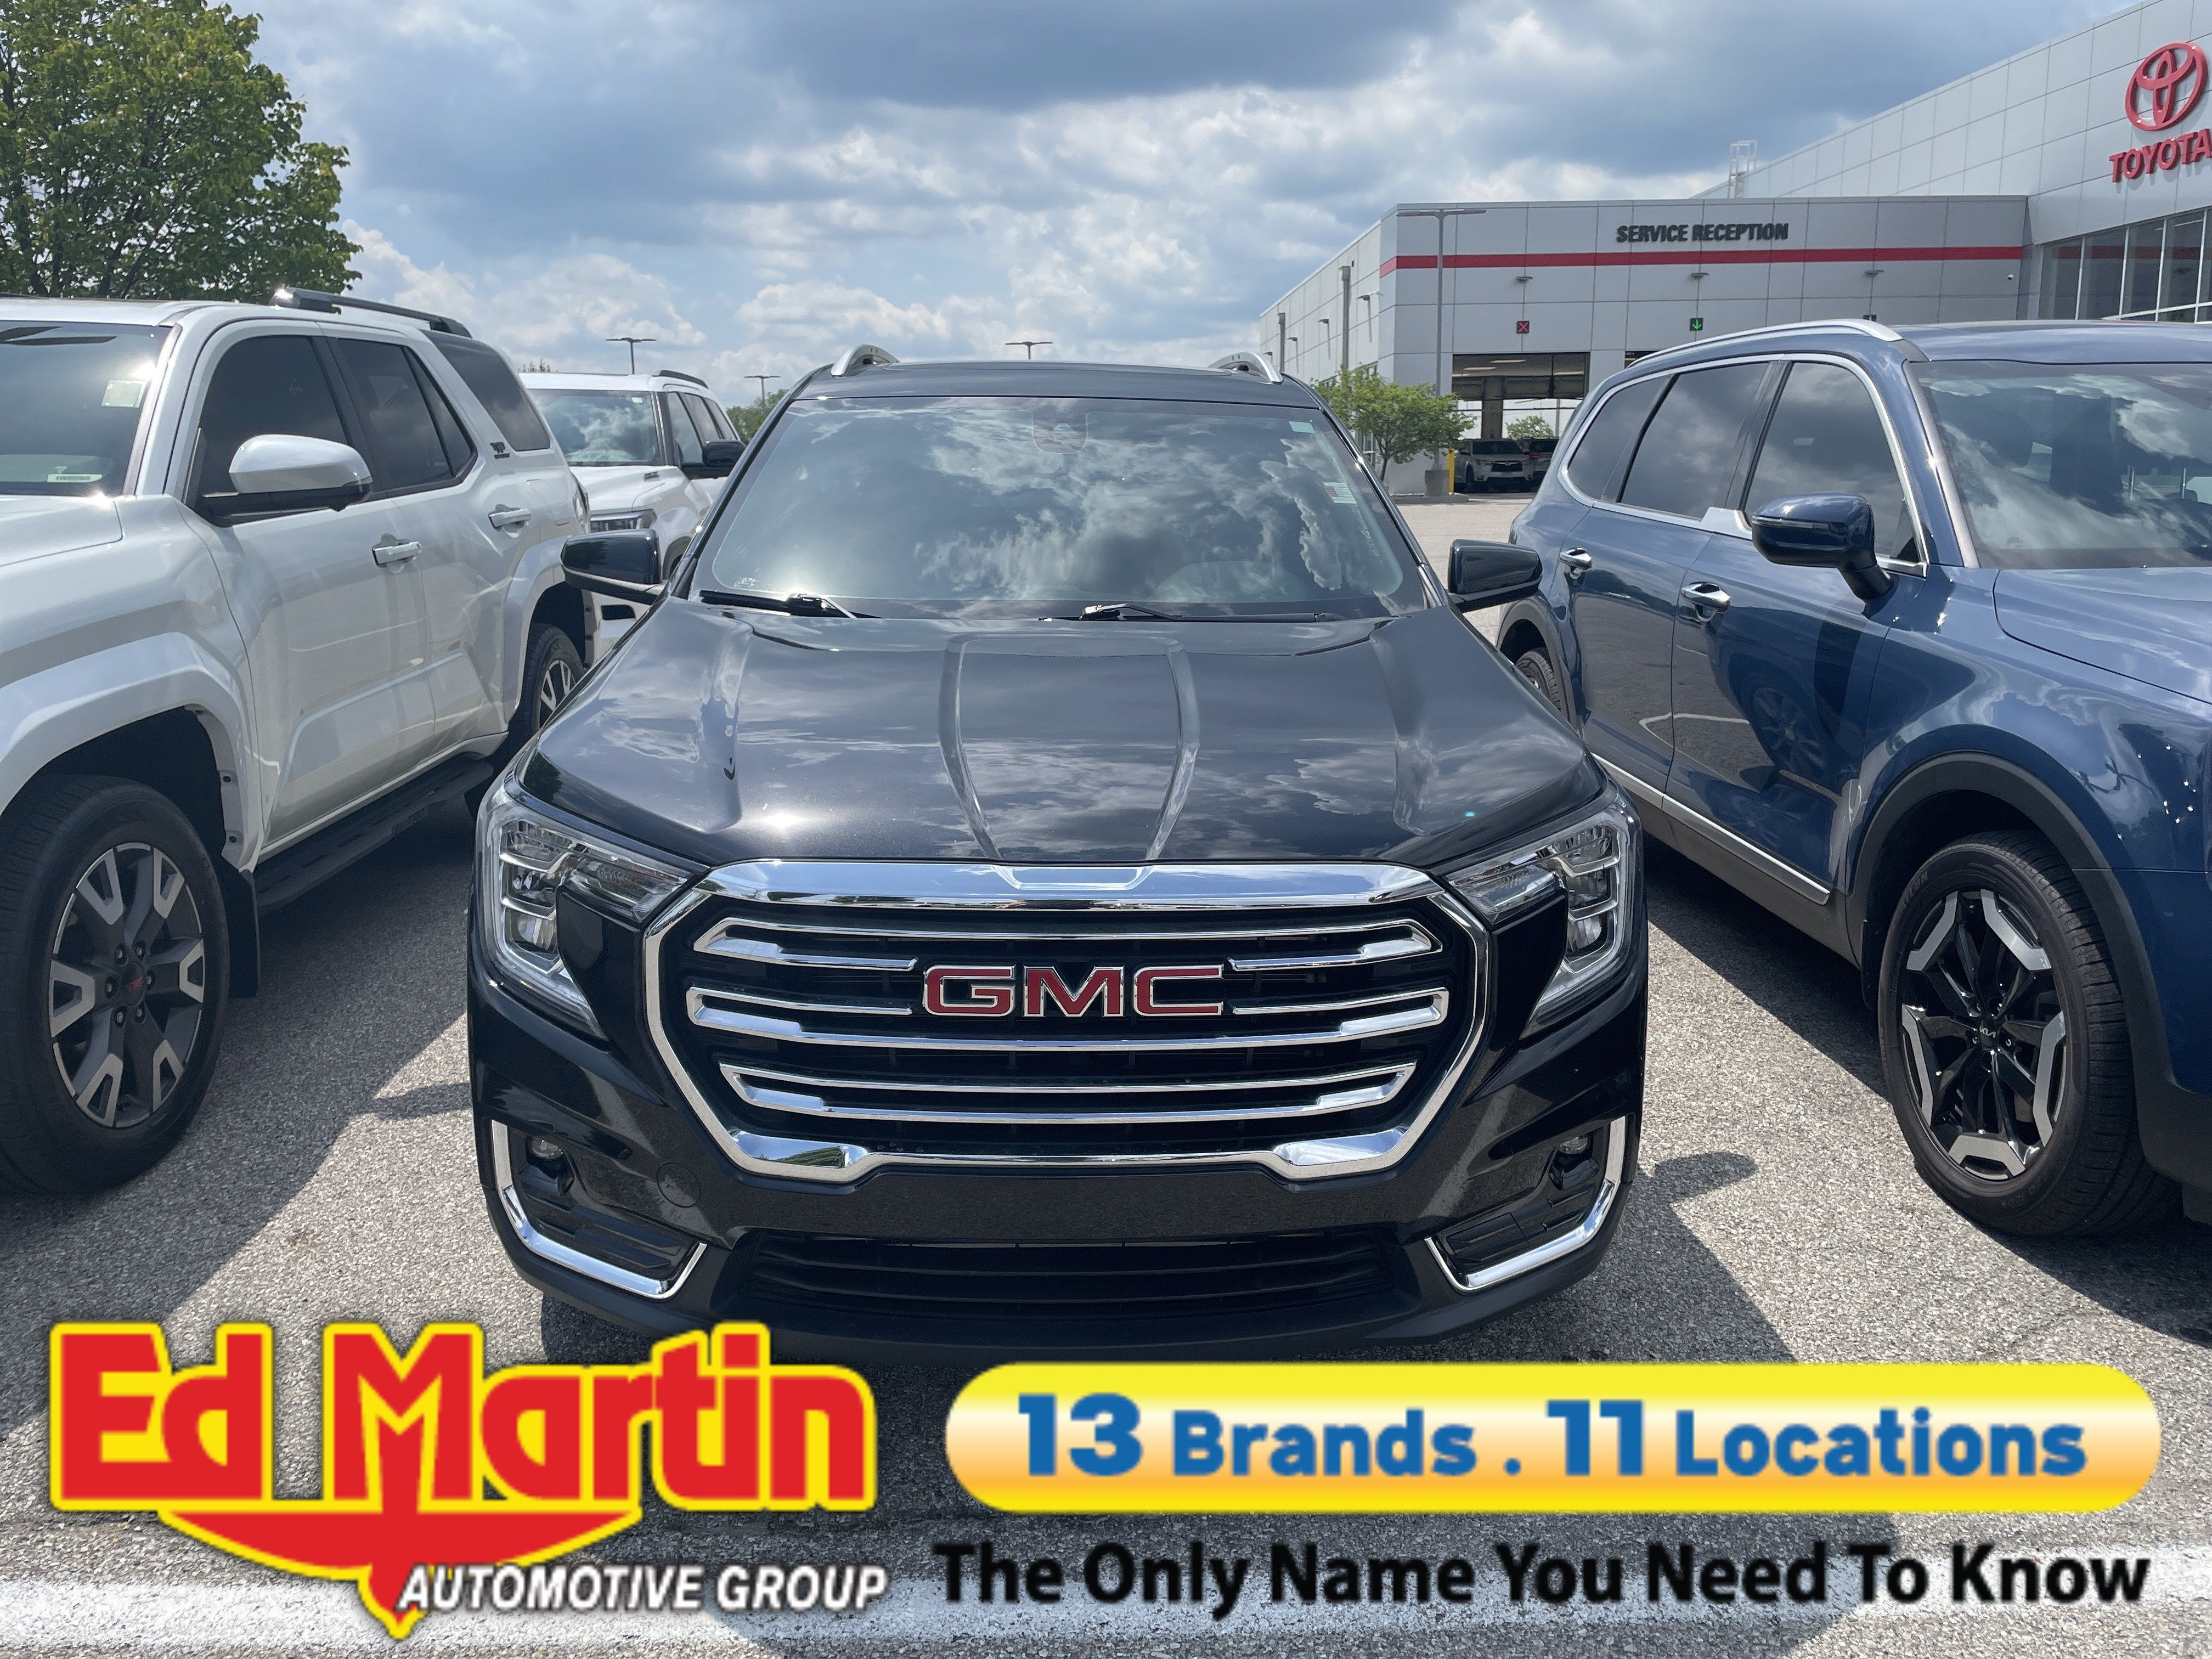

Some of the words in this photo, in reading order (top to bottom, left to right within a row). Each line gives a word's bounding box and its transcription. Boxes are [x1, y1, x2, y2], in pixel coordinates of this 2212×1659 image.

[2108, 128, 2212, 183] TOYOTA
[1616, 224, 1689, 242] SERVICE
[1691, 222, 1789, 241] RECEPTION
[922, 964, 1224, 1017] GMC
